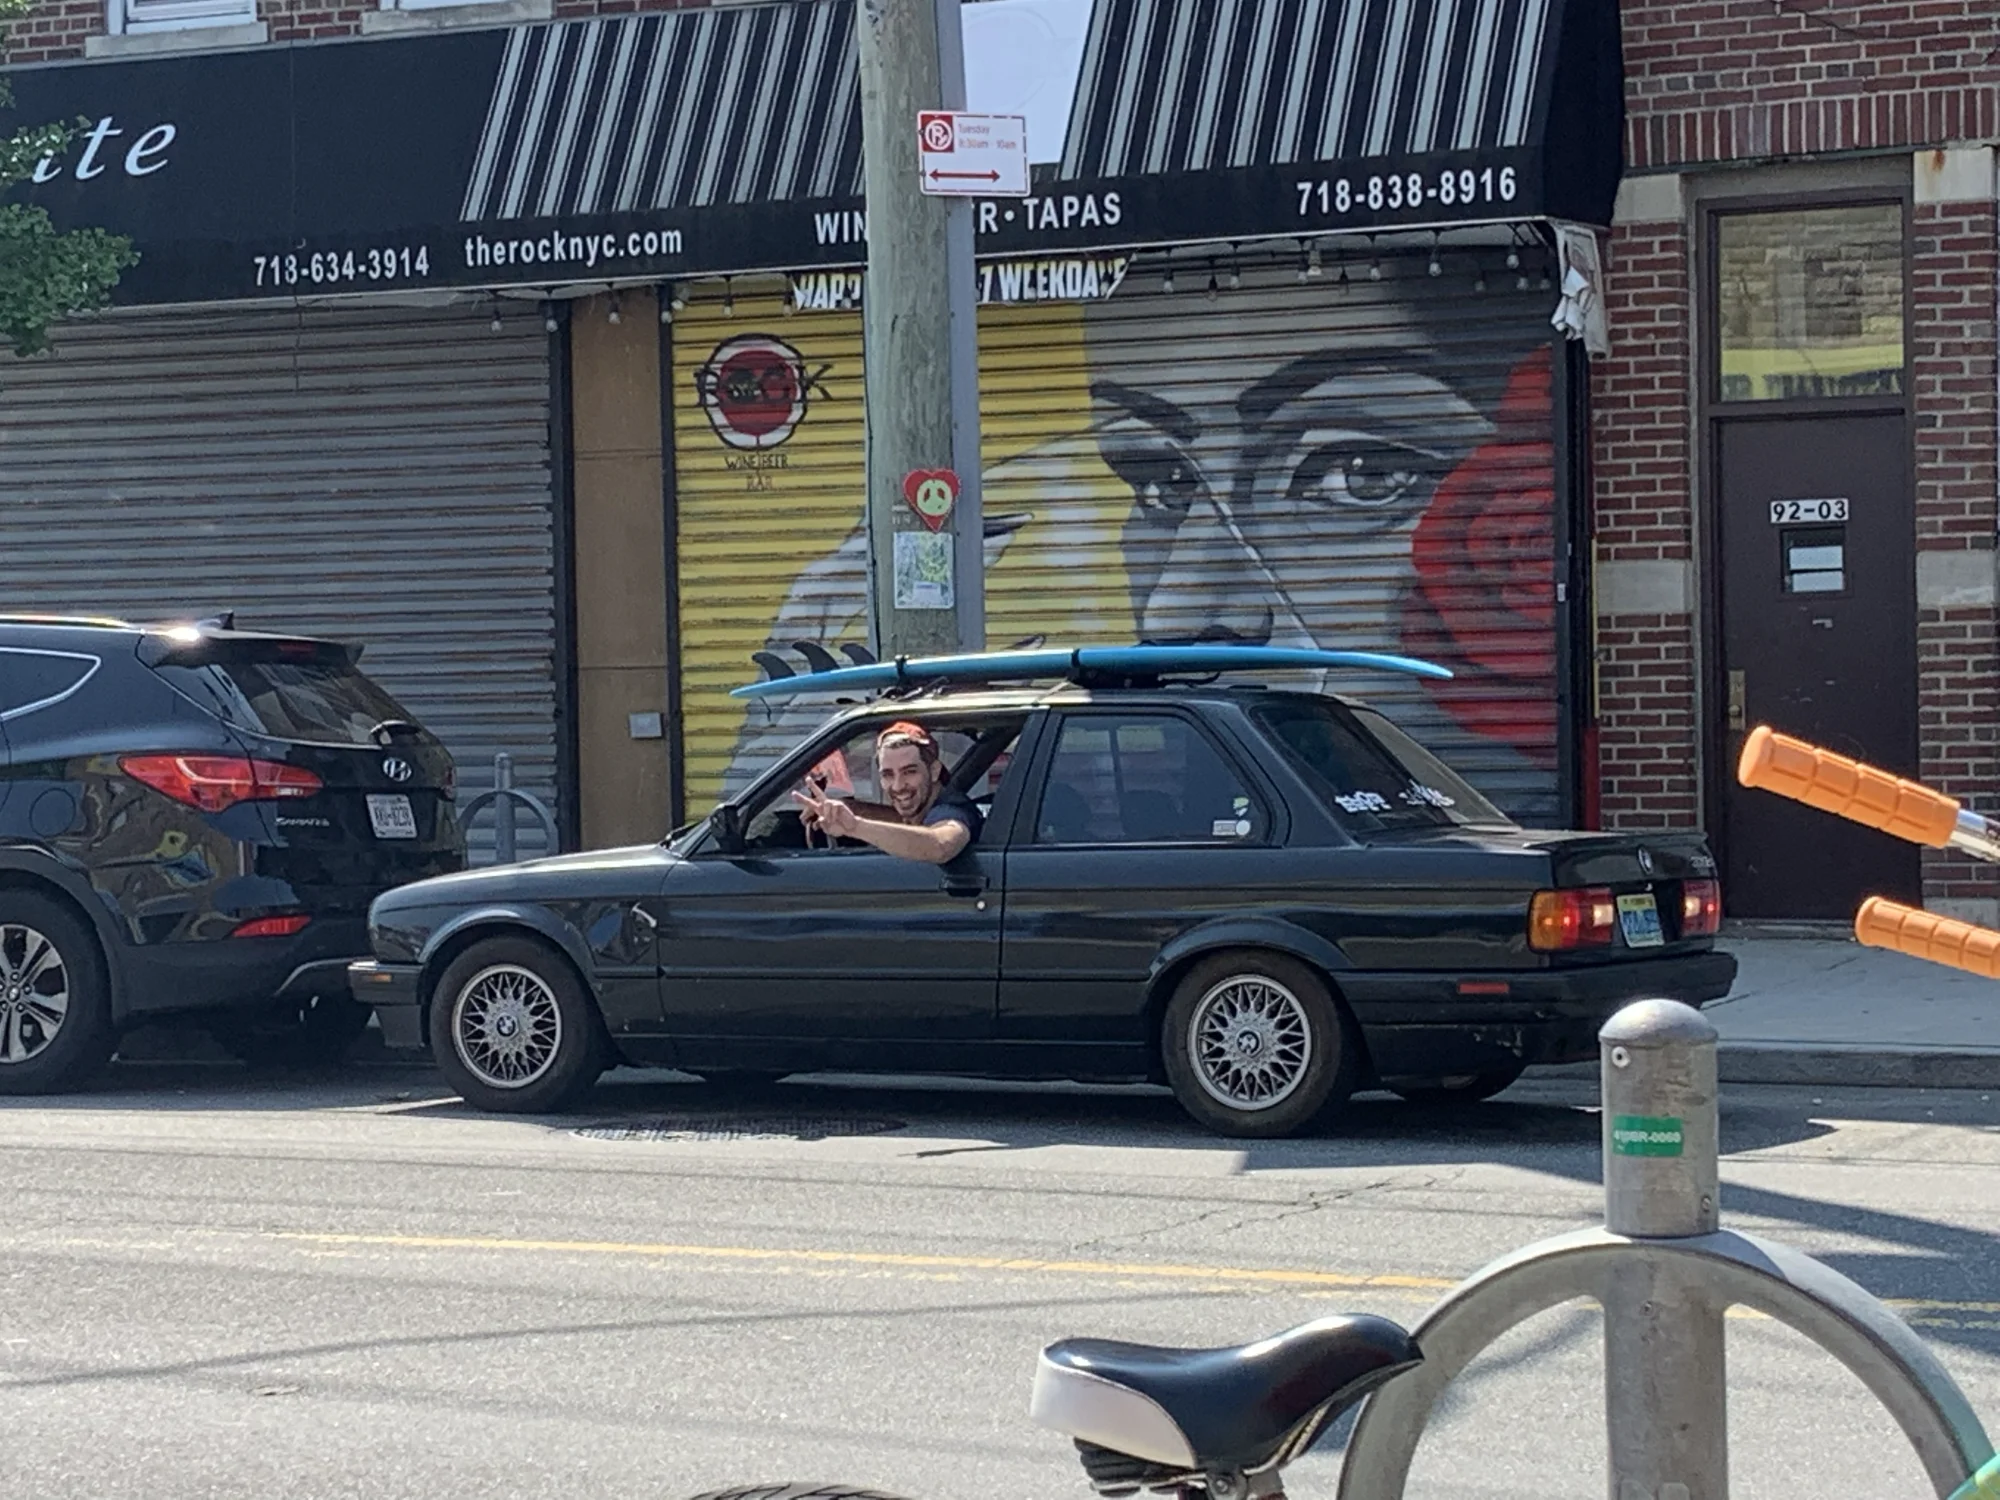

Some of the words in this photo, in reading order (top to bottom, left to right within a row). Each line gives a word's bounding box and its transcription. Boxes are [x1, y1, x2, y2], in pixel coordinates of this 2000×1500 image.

[958, 123, 990, 136] Tuesday
[1297, 166, 1517, 216] 718-838-8916
[814, 209, 868, 245] WIN
[1022, 193, 1122, 230] TAPAS
[253, 245, 431, 286] 718-634-3914
[464, 228, 683, 268] therocknyc.com
[1772, 500, 1847, 522] 92-03
